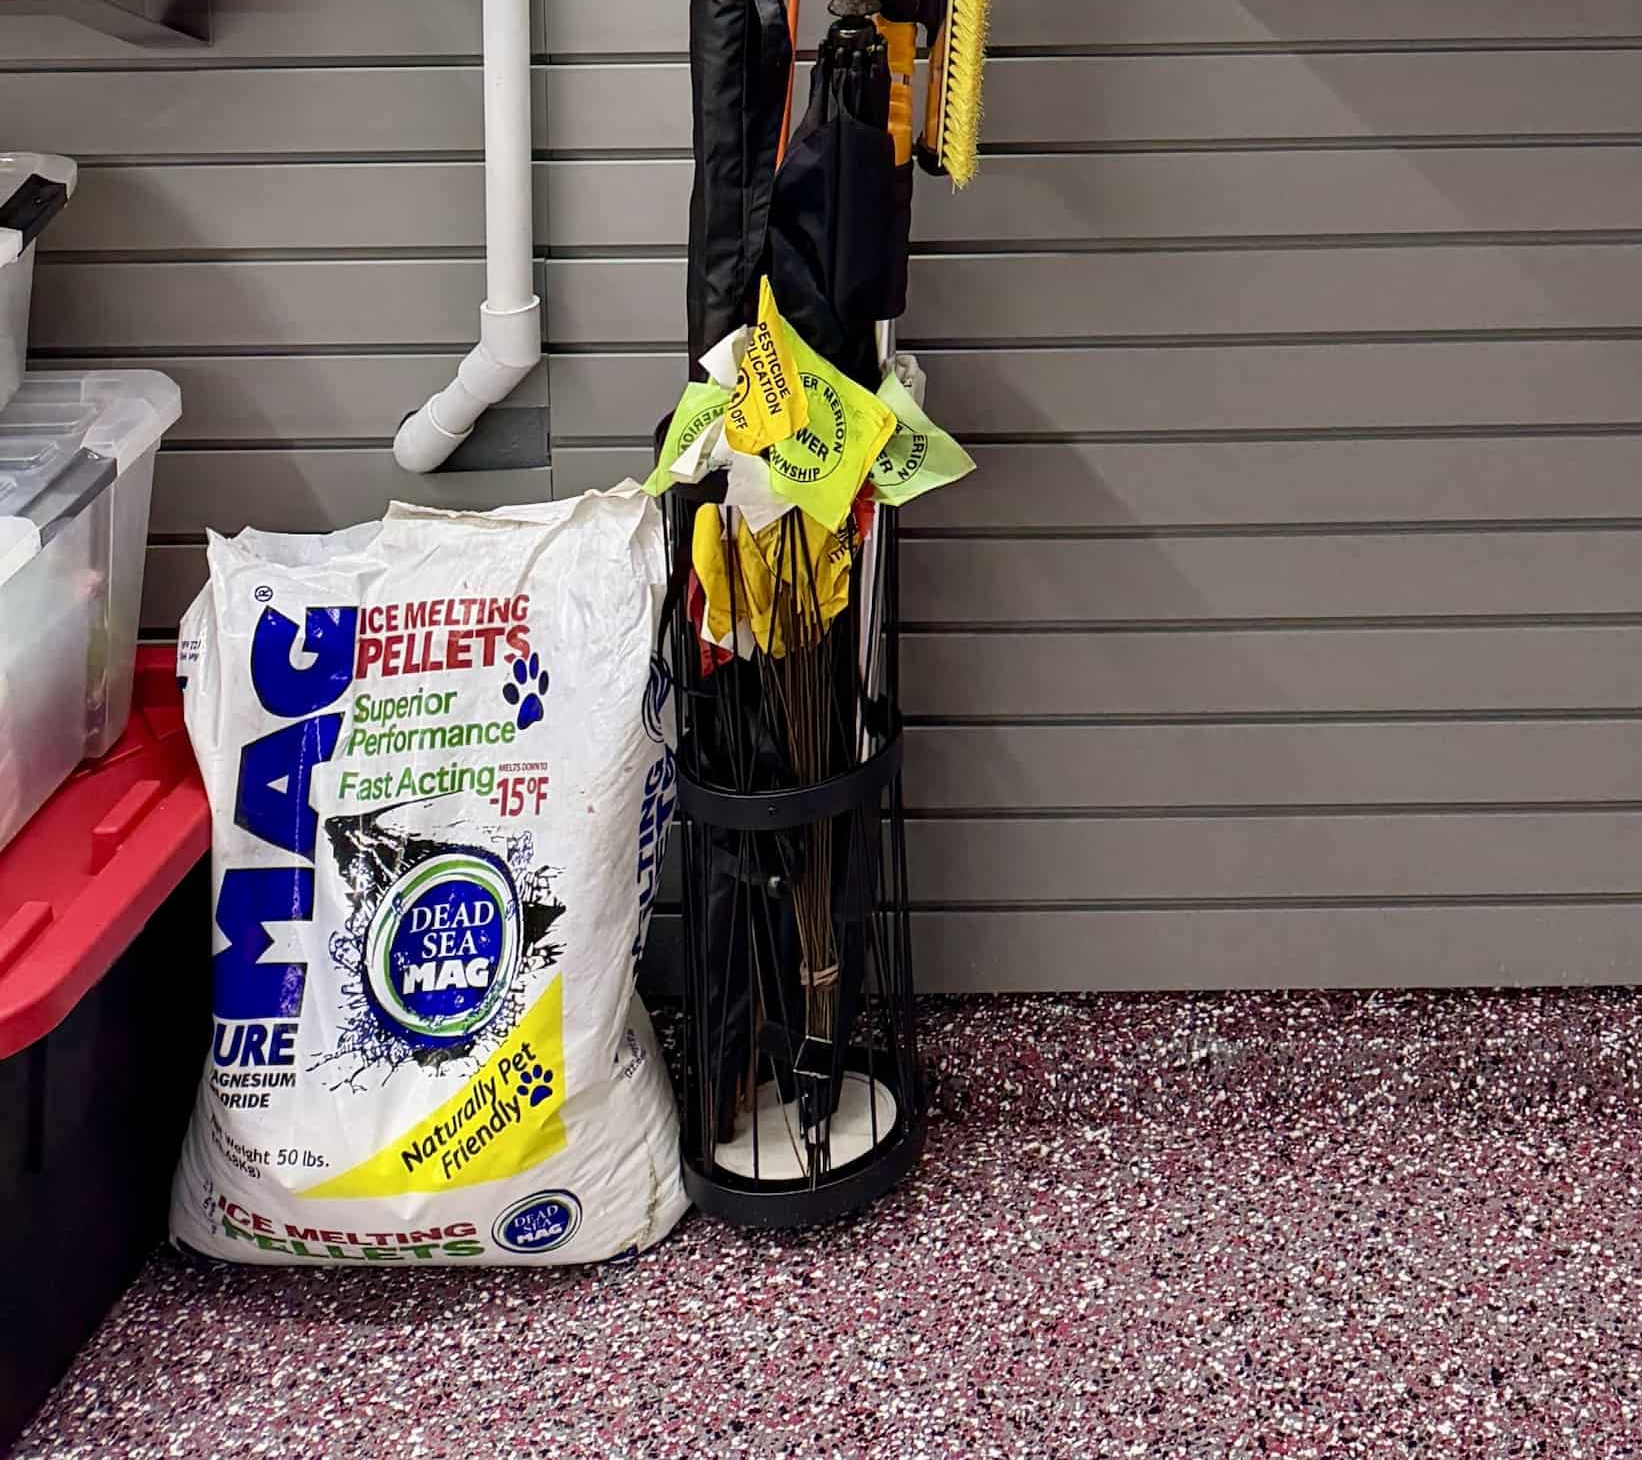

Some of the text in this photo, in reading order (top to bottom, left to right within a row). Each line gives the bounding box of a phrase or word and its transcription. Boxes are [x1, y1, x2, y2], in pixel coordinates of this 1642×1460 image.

[757, 322, 791, 399] PESTICIDE
[731, 409, 749, 430] OFF
[823, 388, 845, 454] MERION
[770, 445, 821, 481] WNSHIP
[796, 427, 829, 463] WER
[897, 434, 925, 480] ERION
[360, 594, 530, 635] ICE MELTING
[355, 624, 530, 679] PELLETS
[353, 688, 458, 728] Superior
[348, 721, 516, 757] Performance
[339, 762, 494, 801] Fast Acting
[212, 604, 359, 1019] MAG
[410, 901, 494, 933] DEAD
[422, 930, 478, 959] SEA
[403, 957, 490, 995] MAG
[213, 1024, 299, 1067] URE
[210, 1069, 296, 1088] AGNESIUM
[220, 1093, 270, 1109] ORIDE
[401, 1041, 536, 1173] Naturally Pet
[441, 1095, 521, 1179] Friendly
[277, 1149, 298, 1166] 50
[302, 1150, 329, 1168] lbs.
[218, 1194, 276, 1234] ICE
[284, 1222, 476, 1246] MELTING
[514, 1205, 559, 1227] DEAD
[517, 1223, 562, 1244] MAG
